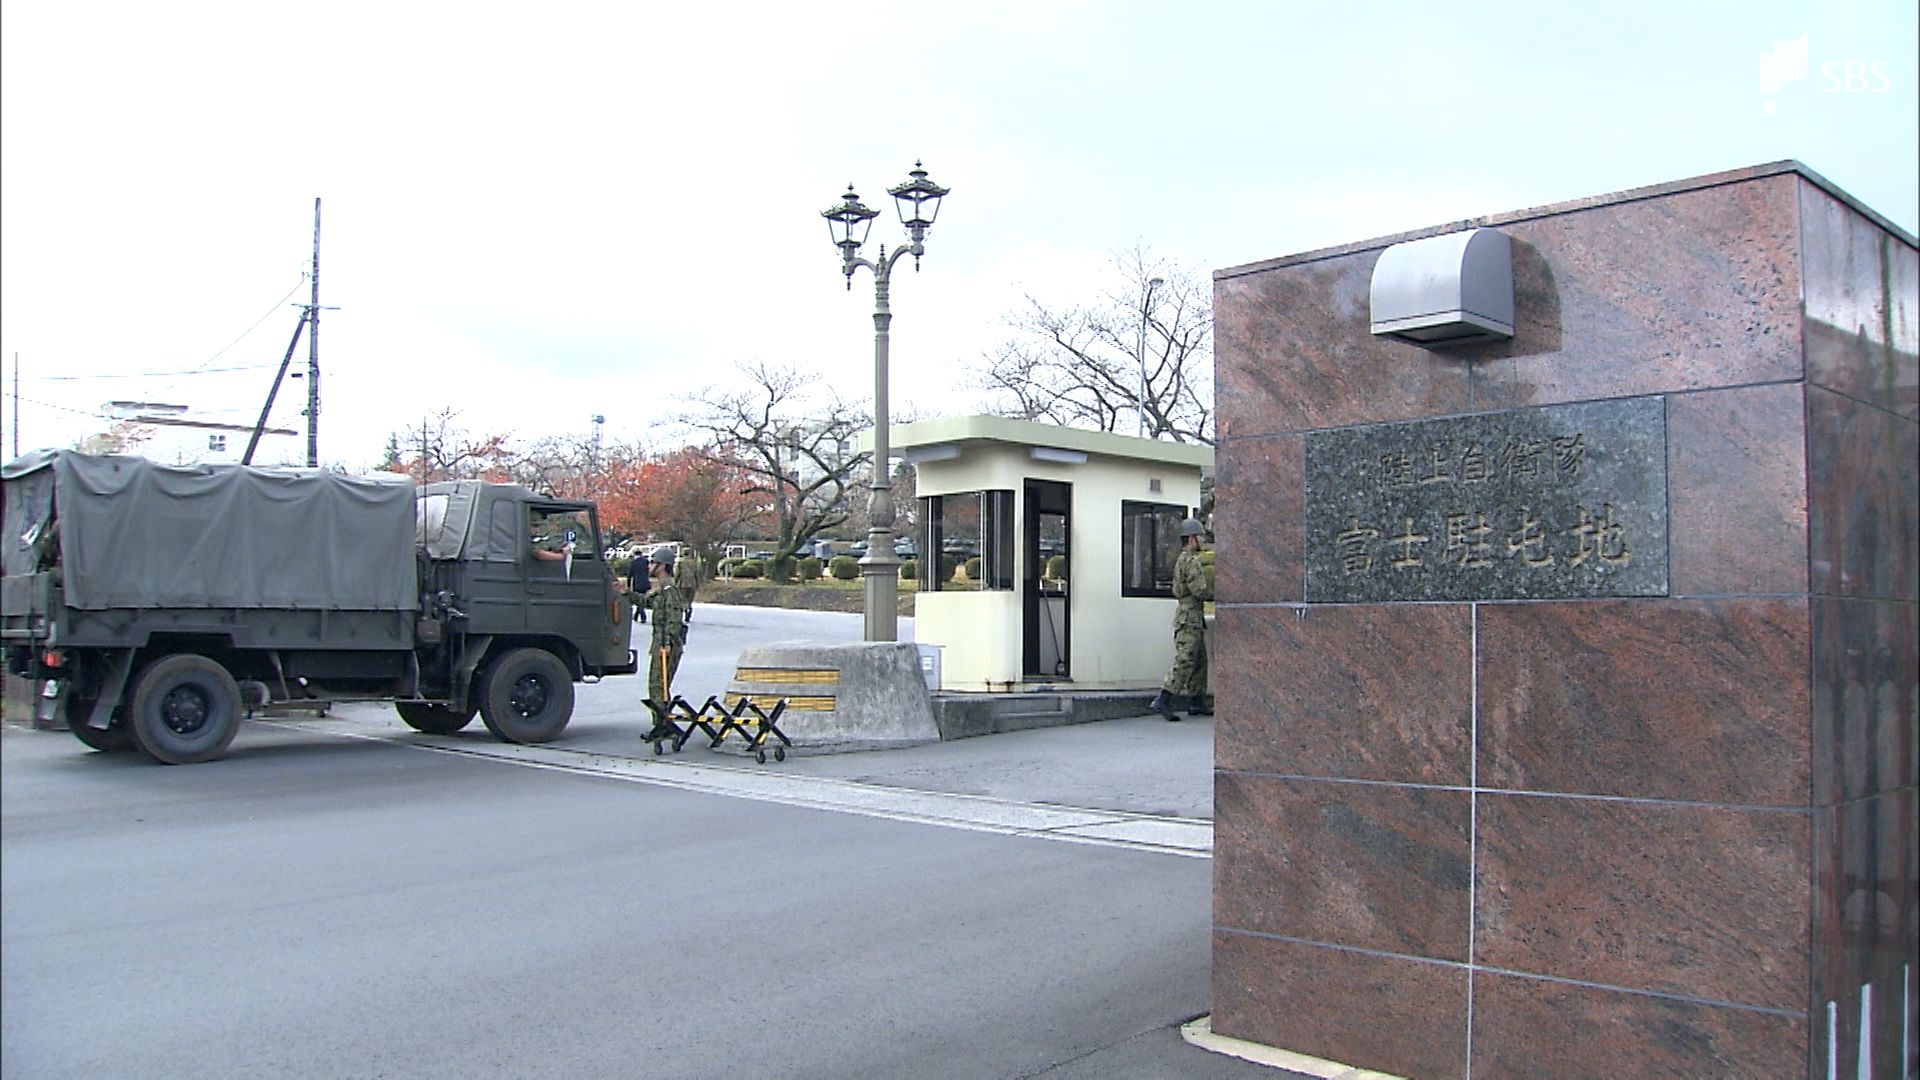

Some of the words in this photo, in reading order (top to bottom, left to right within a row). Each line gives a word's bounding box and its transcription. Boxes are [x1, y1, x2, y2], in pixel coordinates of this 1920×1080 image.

[1379, 433, 1585, 487] 陸上自衛隊
[1335, 503, 1630, 575] 富士駐屯地
